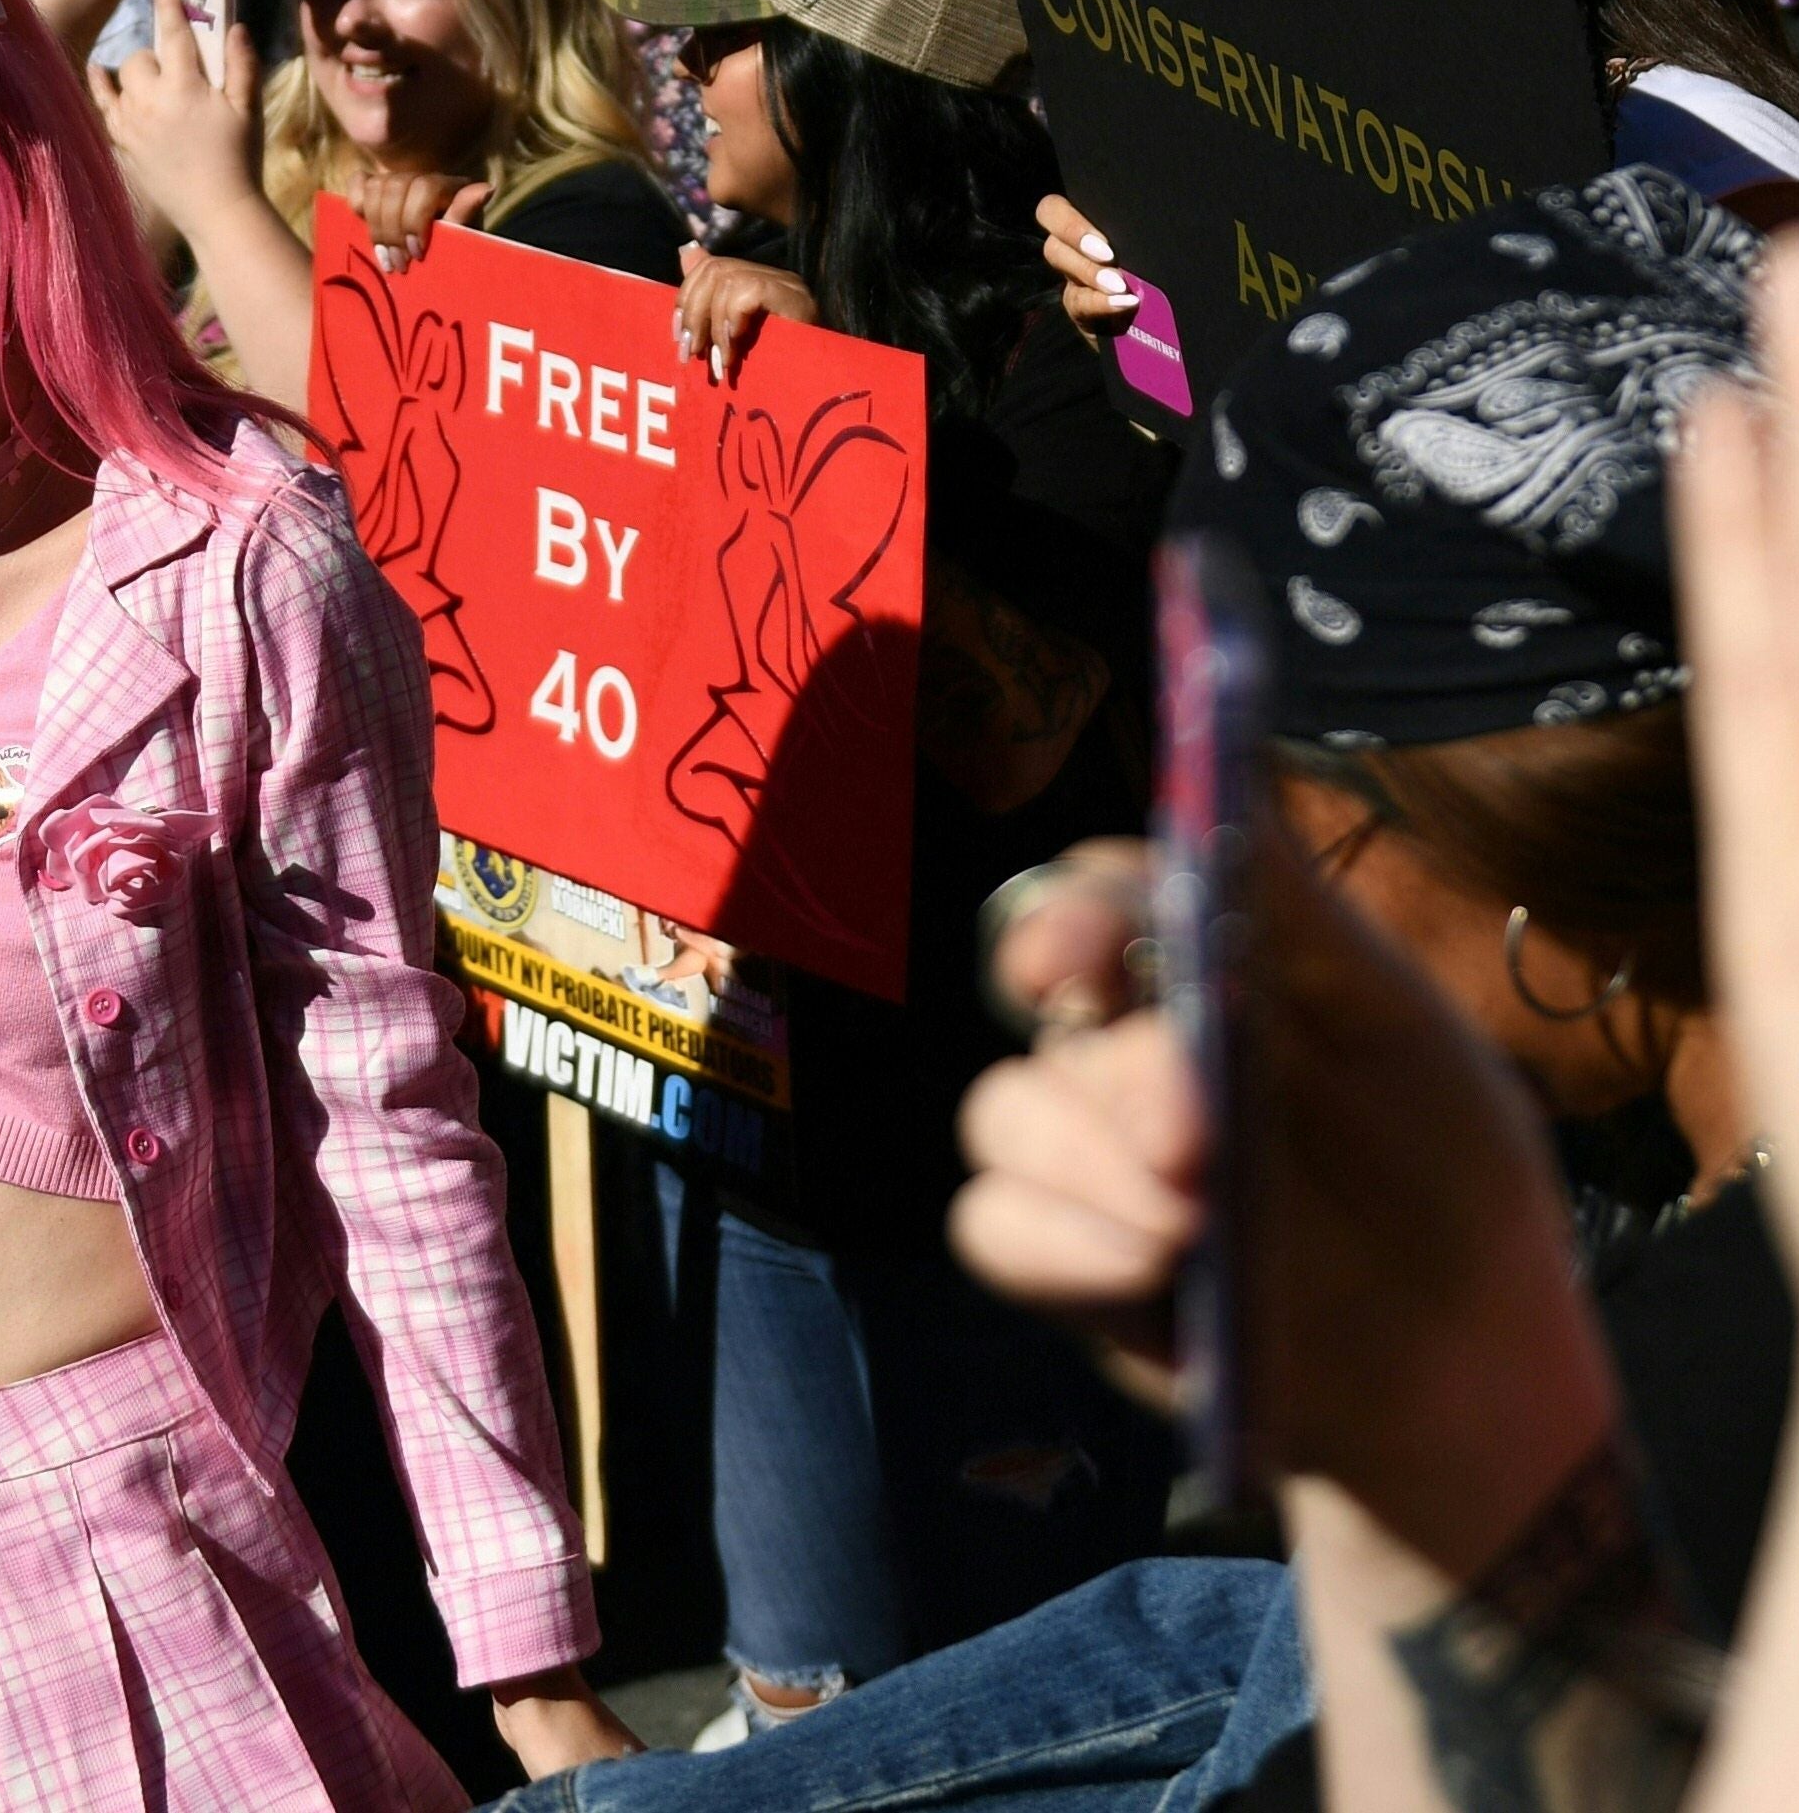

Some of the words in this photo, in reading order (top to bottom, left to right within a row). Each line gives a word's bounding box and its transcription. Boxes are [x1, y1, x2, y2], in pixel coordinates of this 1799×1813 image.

[485, 320, 677, 468] FREE
[534, 487, 640, 602] BY
[530, 649, 638, 759] 40
[454, 924, 516, 981] OUNTY
[520, 949, 548, 993] NY
[550, 971, 644, 1042] PROBATE
